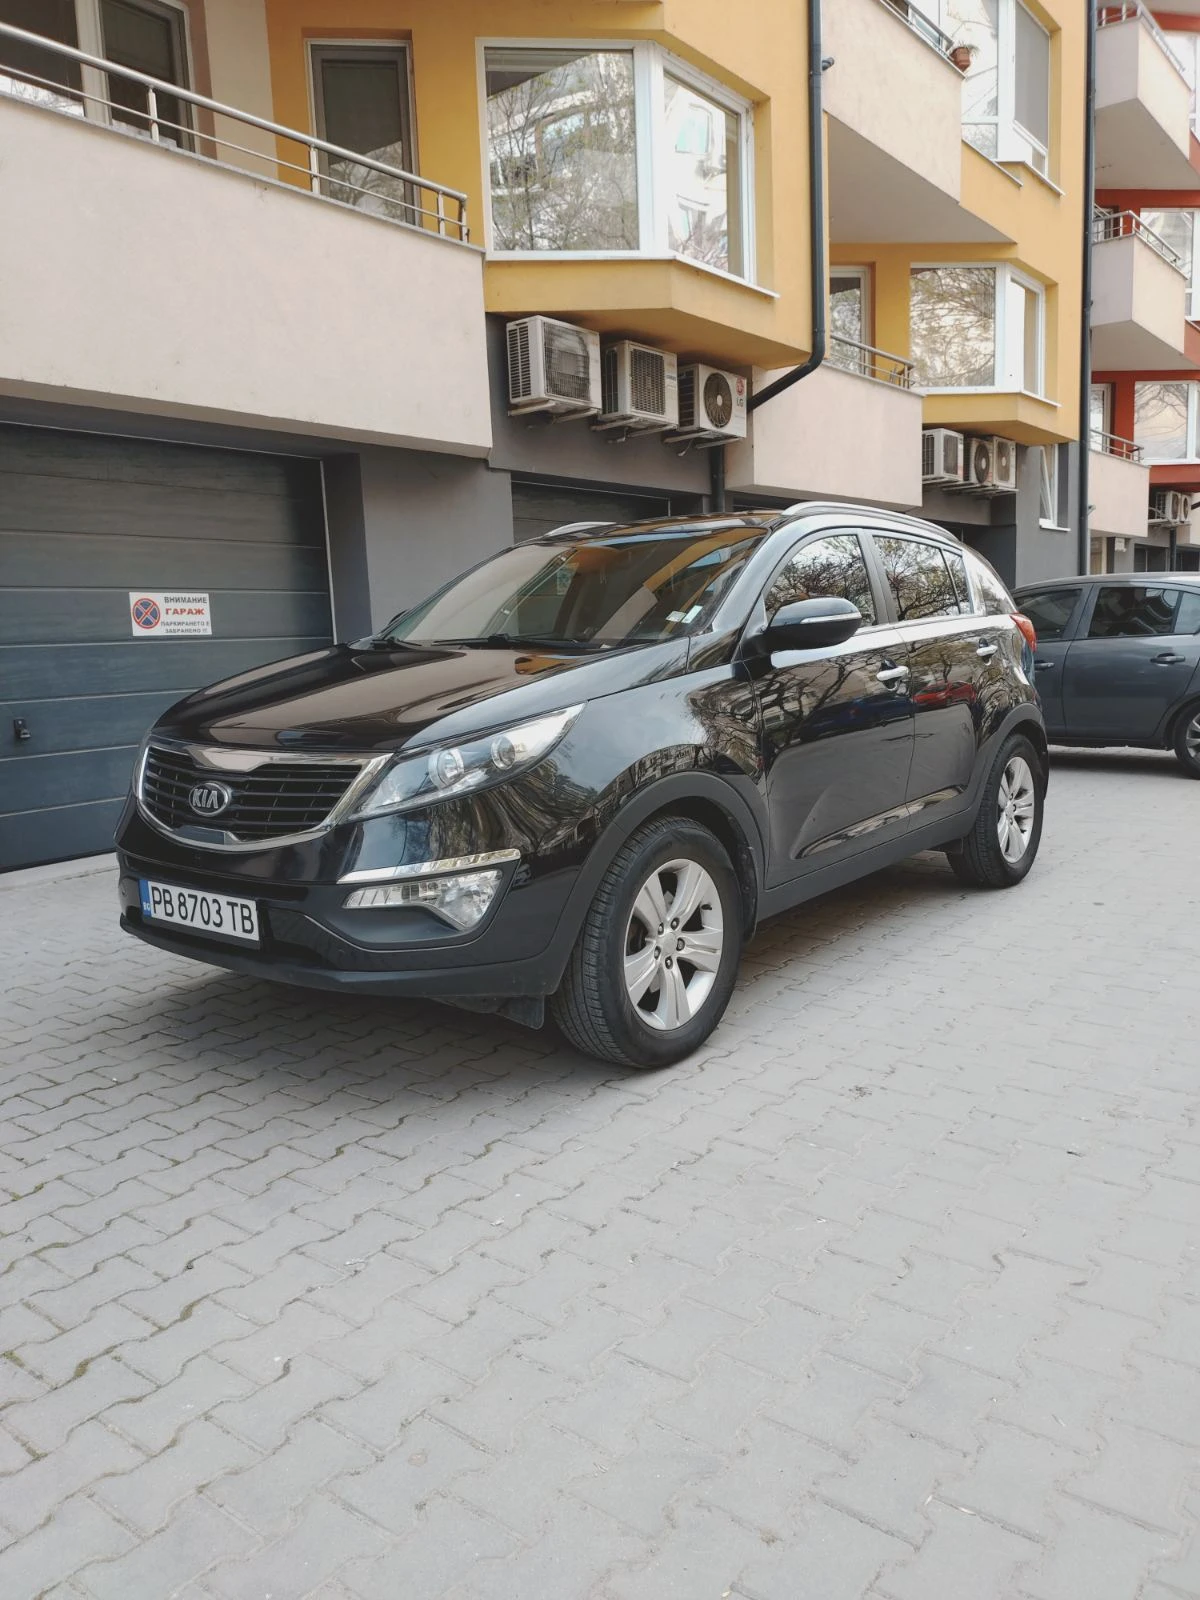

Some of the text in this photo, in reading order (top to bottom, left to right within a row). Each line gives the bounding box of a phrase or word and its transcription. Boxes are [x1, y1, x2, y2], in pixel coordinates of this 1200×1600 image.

[737, 398, 744, 407] LG
[164, 596, 207, 604] ВНИМАНИЕ
[193, 788, 219, 809] KIA
[151, 886, 255, 934] PB 8703 TB
